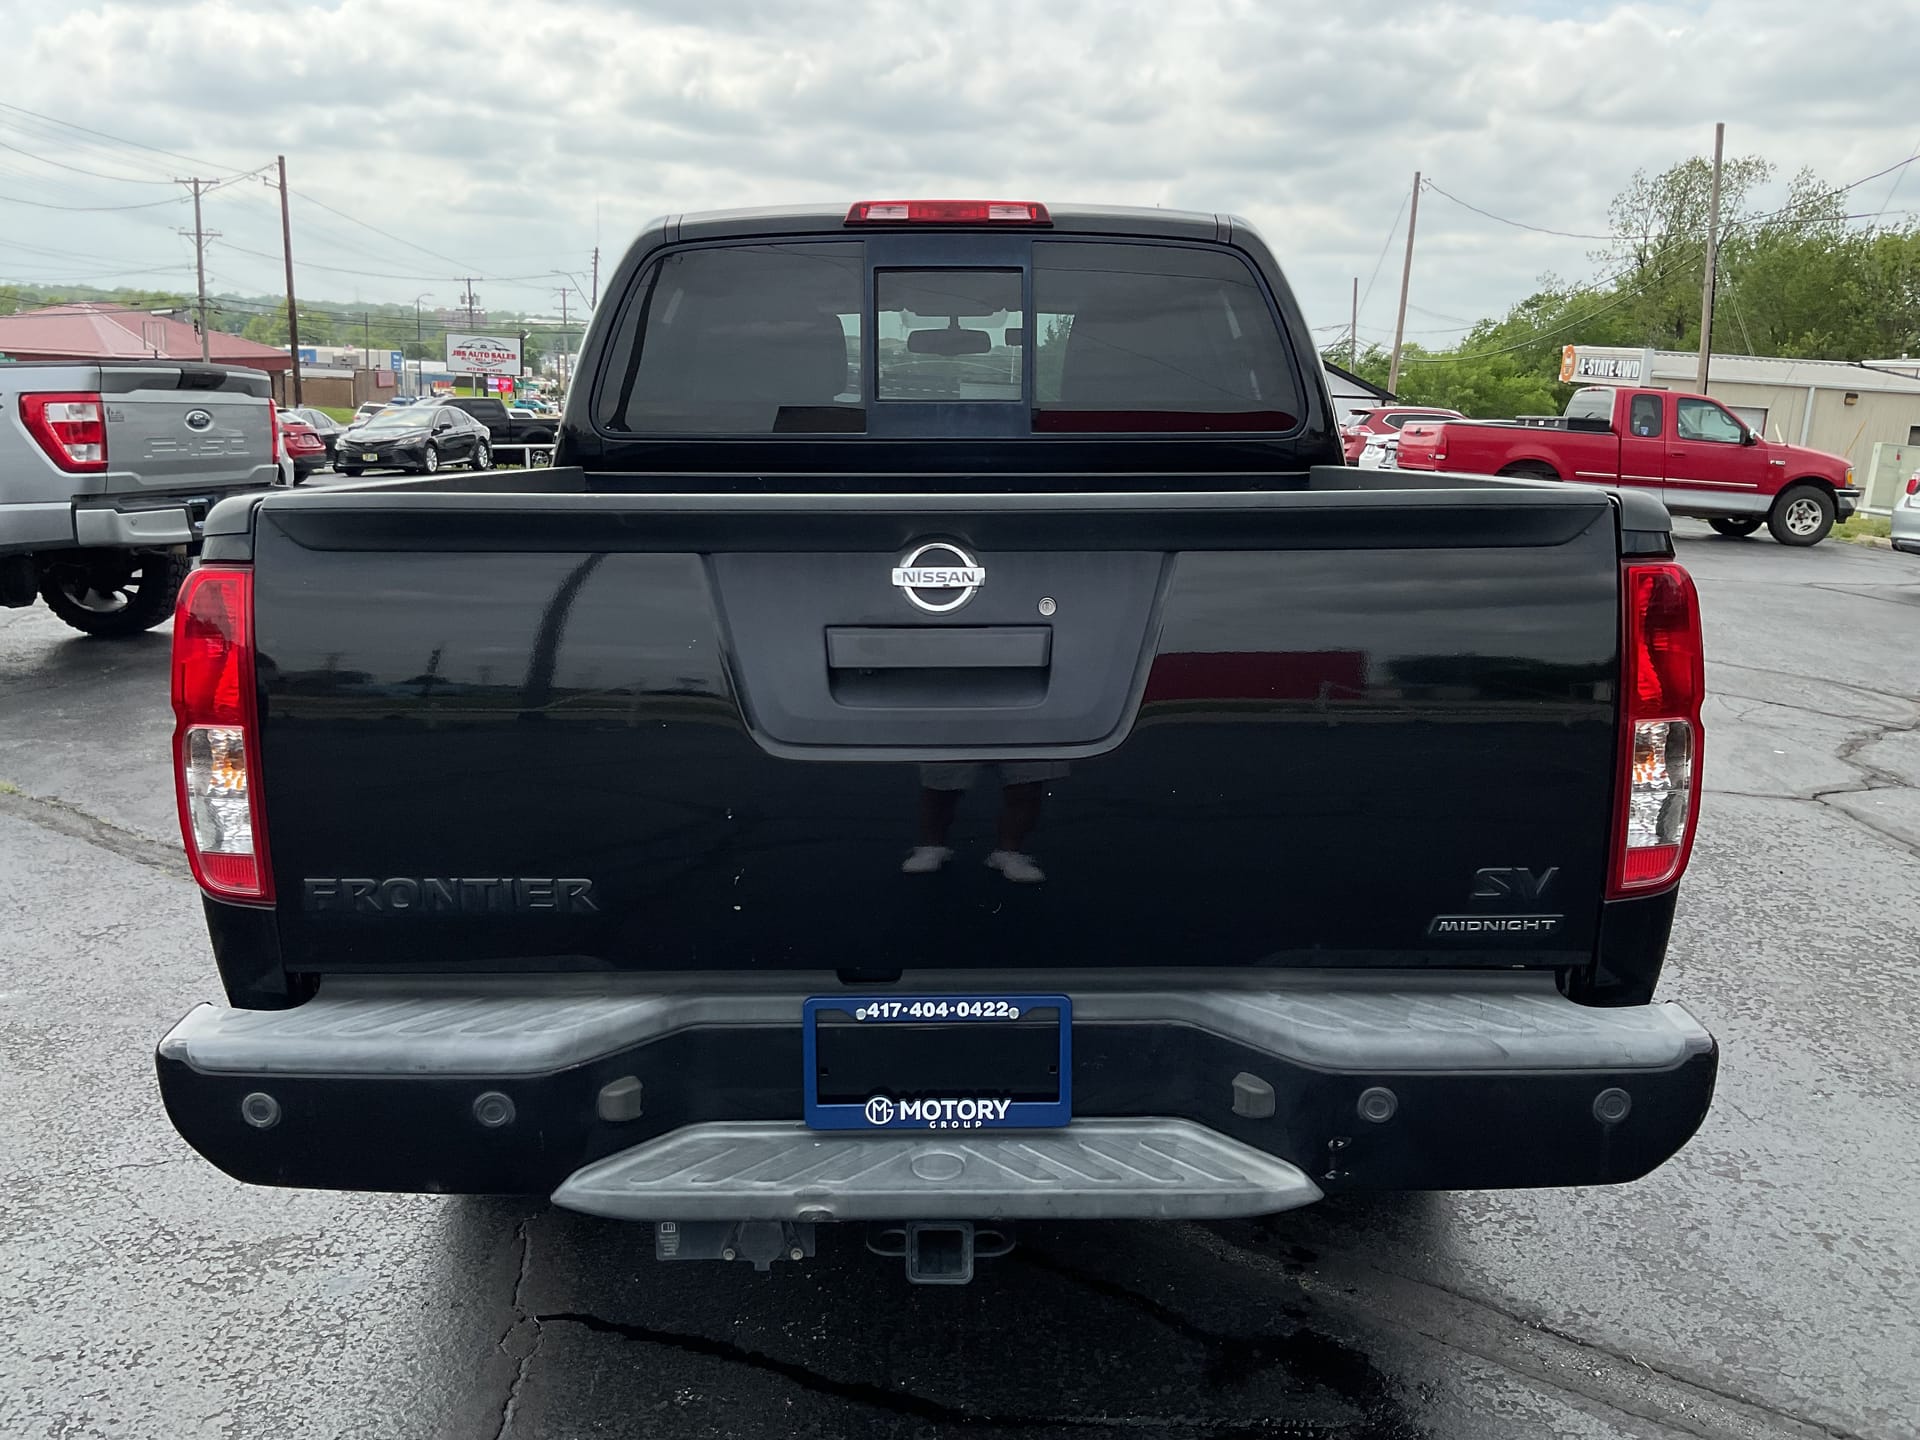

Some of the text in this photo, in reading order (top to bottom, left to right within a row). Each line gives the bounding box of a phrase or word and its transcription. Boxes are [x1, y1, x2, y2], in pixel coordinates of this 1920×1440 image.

[491, 352, 517, 360] SALES
[1578, 358, 1615, 377] 4-STATE
[1615, 360, 1640, 378] 4WD
[902, 571, 975, 583] NISSAN
[1470, 867, 1560, 899] SV
[303, 877, 600, 913] FRONTIER
[1438, 920, 1556, 932] MIDNIGHT
[900, 1099, 1012, 1121] MOTORY
[929, 1120, 983, 1129] GROUP
